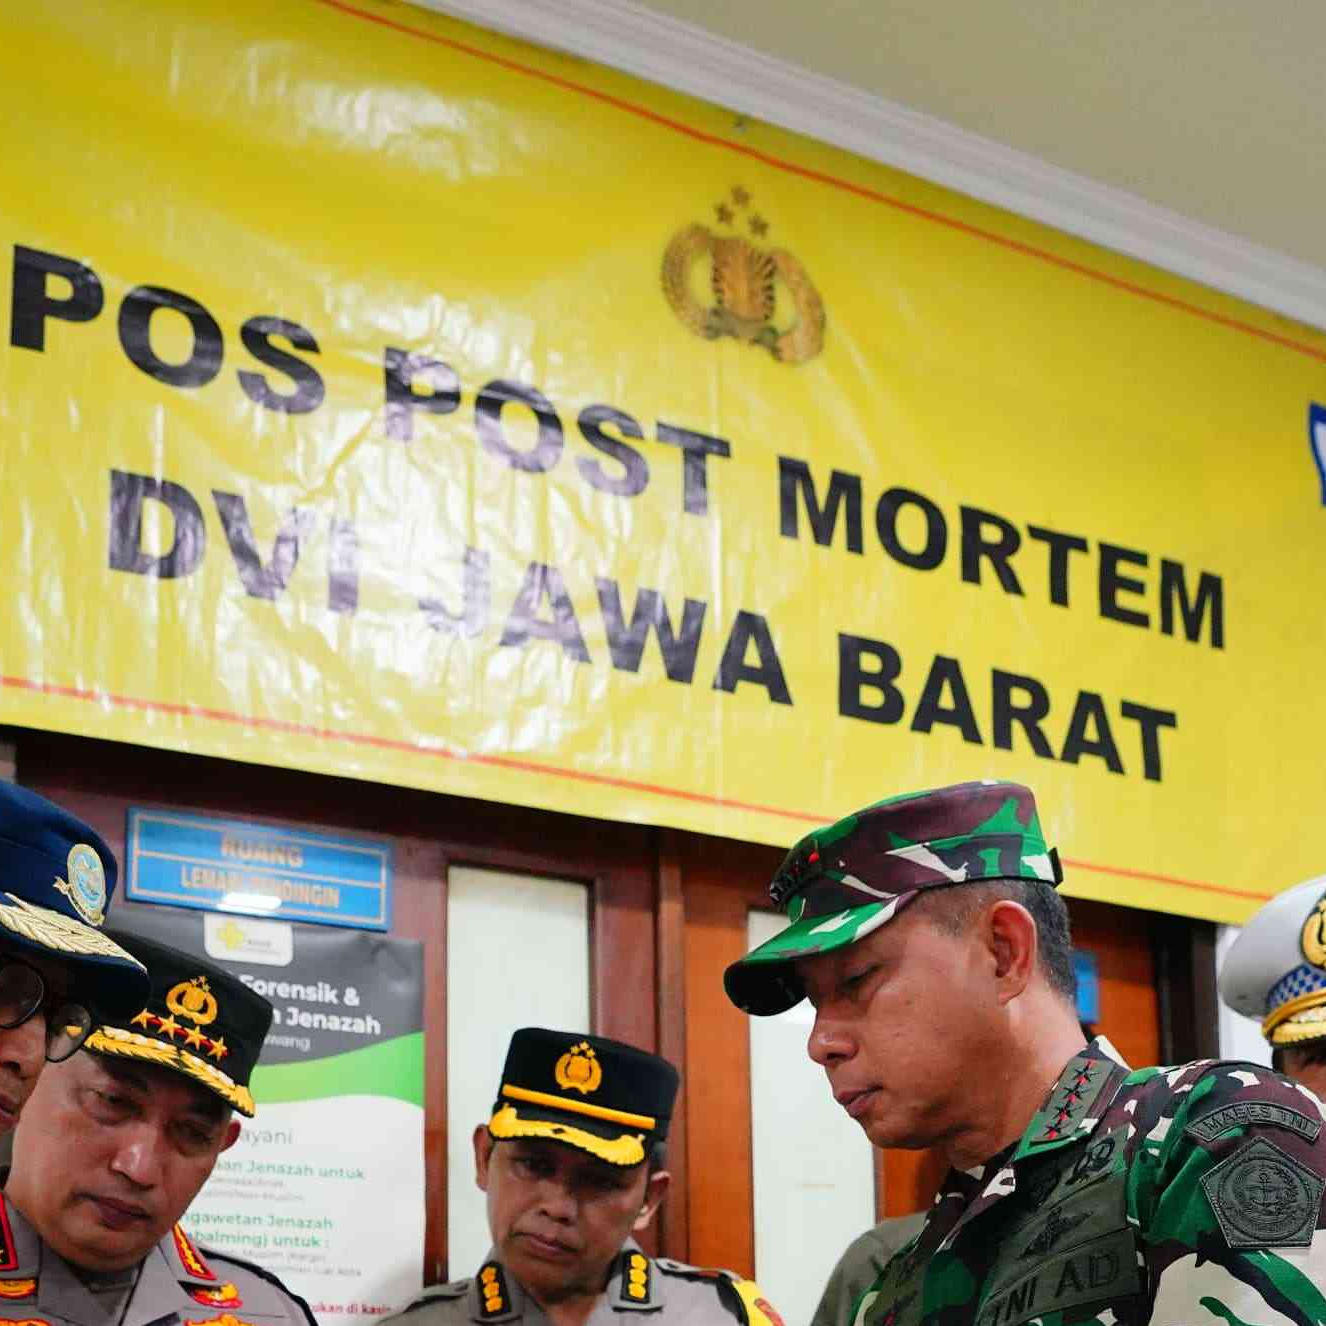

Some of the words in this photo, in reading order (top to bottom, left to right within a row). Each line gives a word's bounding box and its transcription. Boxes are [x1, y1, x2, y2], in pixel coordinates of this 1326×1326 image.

[10, 244, 326, 415] POS
[383, 346, 732, 516] POST
[777, 455, 1227, 650] MORTEM
[108, 468, 359, 614] DVI
[417, 546, 793, 706] JAWA
[837, 632, 1177, 782] BARAT
[222, 832, 304, 868] RUANG
[343, 986, 361, 1007] &
[286, 1007, 381, 1036] Jenazah
[272, 1234, 321, 1248] untuk
[1053, 1251, 1121, 1298] AD
